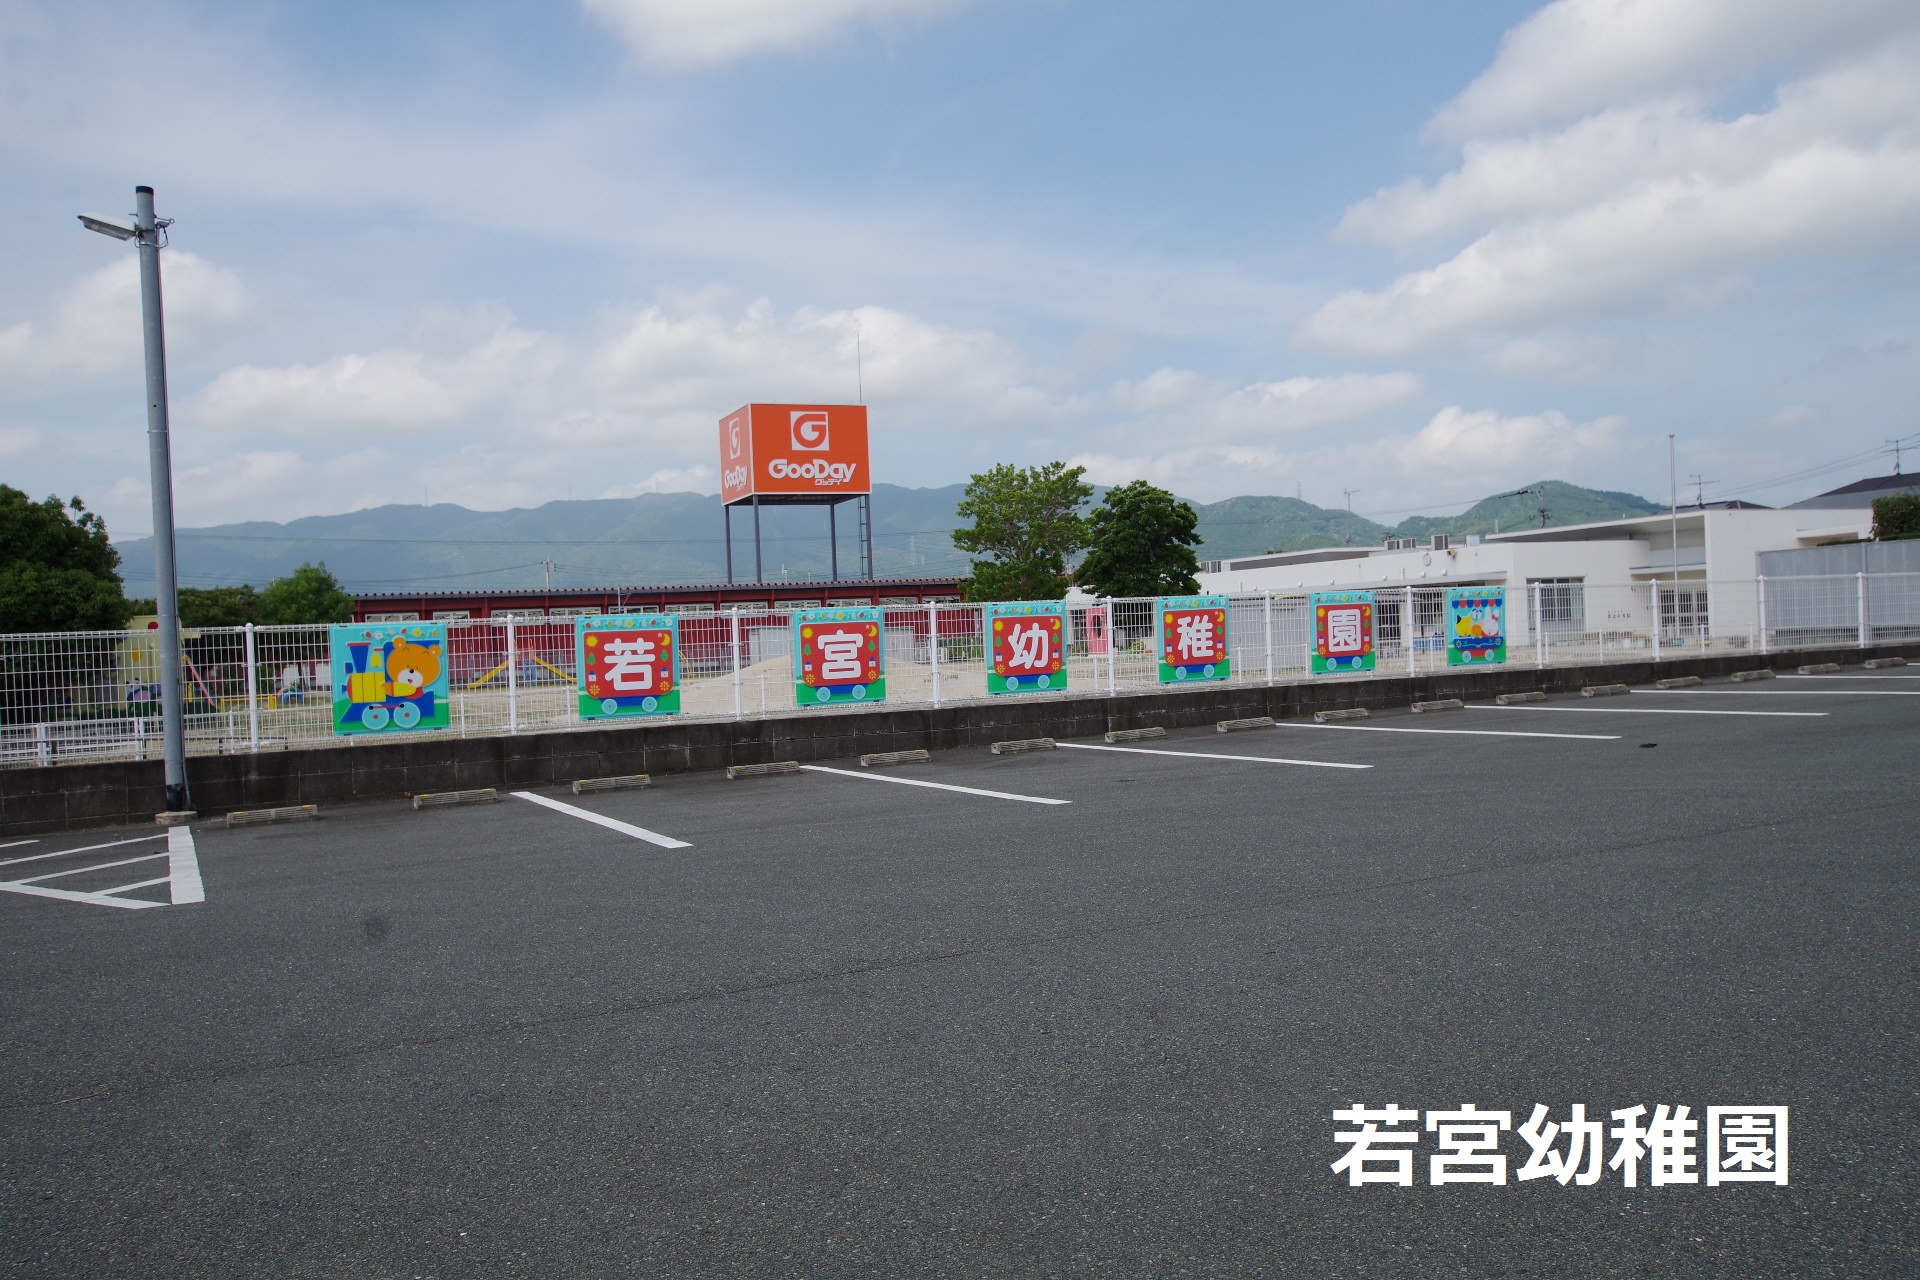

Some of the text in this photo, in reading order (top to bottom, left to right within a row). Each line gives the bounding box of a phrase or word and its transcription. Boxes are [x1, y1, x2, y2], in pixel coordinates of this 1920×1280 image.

[793, 413, 827, 449] G
[768, 458, 857, 482] GooDay
[603, 609, 1362, 691] 若 宮 幼 稚 園
